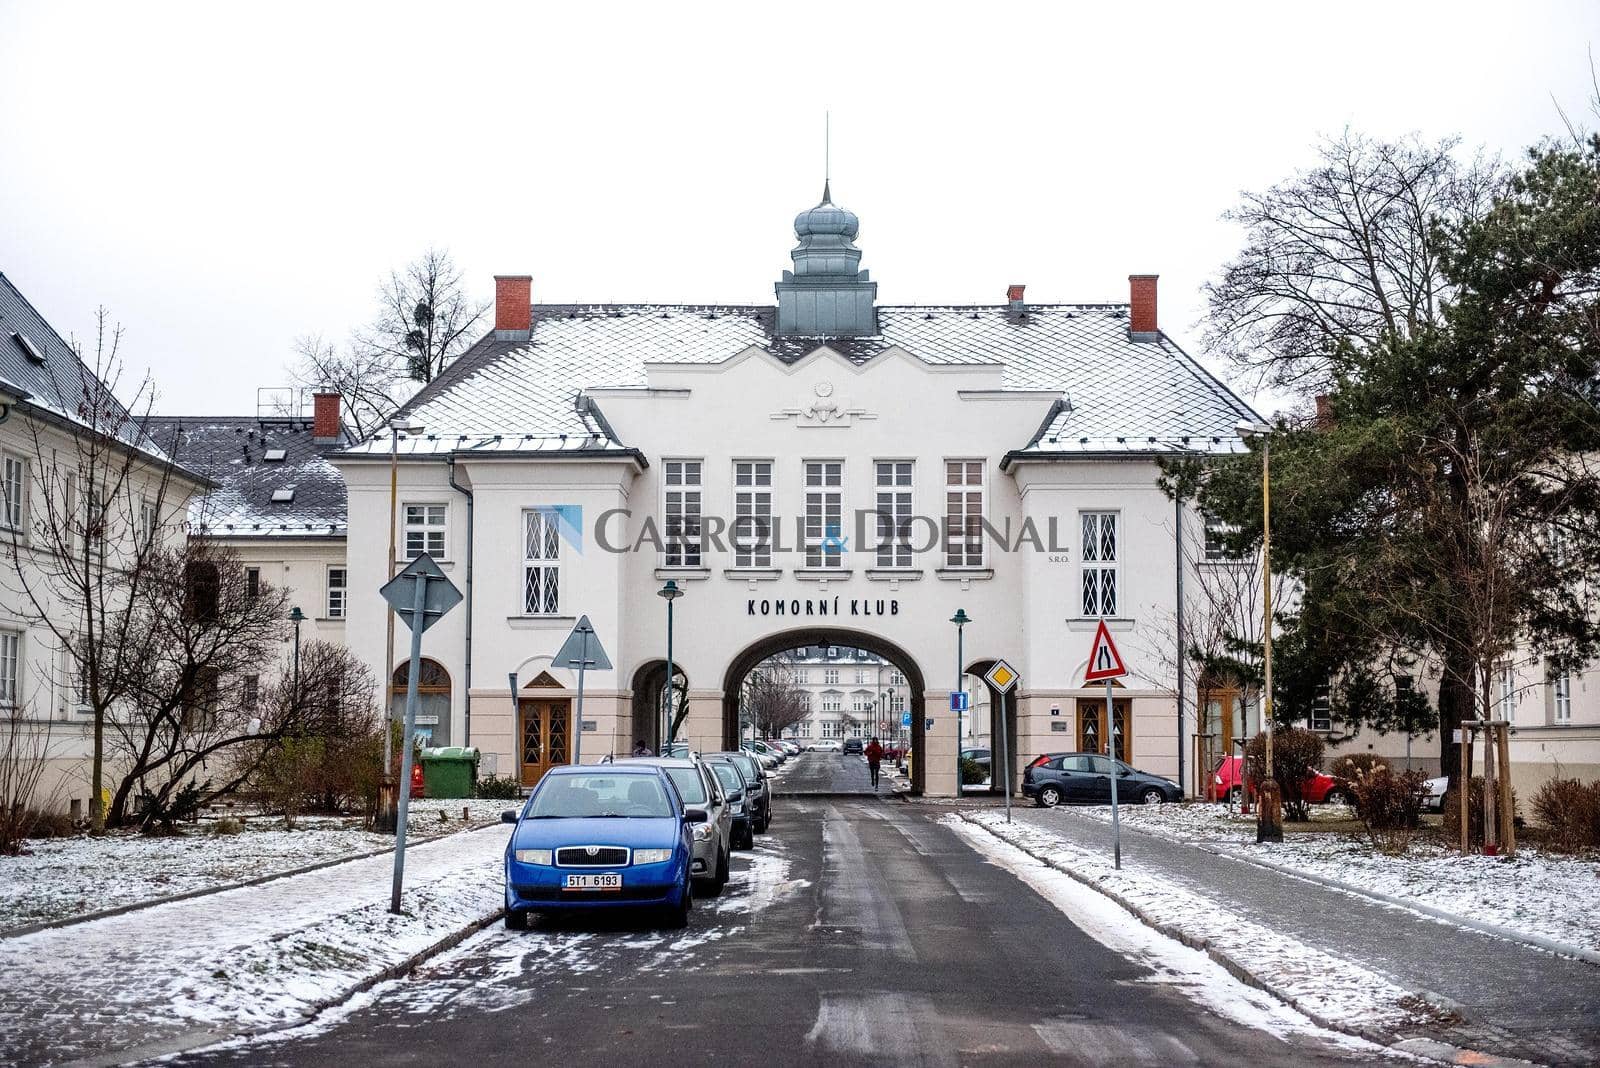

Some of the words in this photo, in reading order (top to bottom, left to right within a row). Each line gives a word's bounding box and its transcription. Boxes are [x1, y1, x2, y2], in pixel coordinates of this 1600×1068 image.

[747, 595, 839, 616] KOMORNÍ
[851, 599, 899, 616] KLUB
[569, 876, 587, 886] 5T1
[593, 876, 618, 886] 6193
